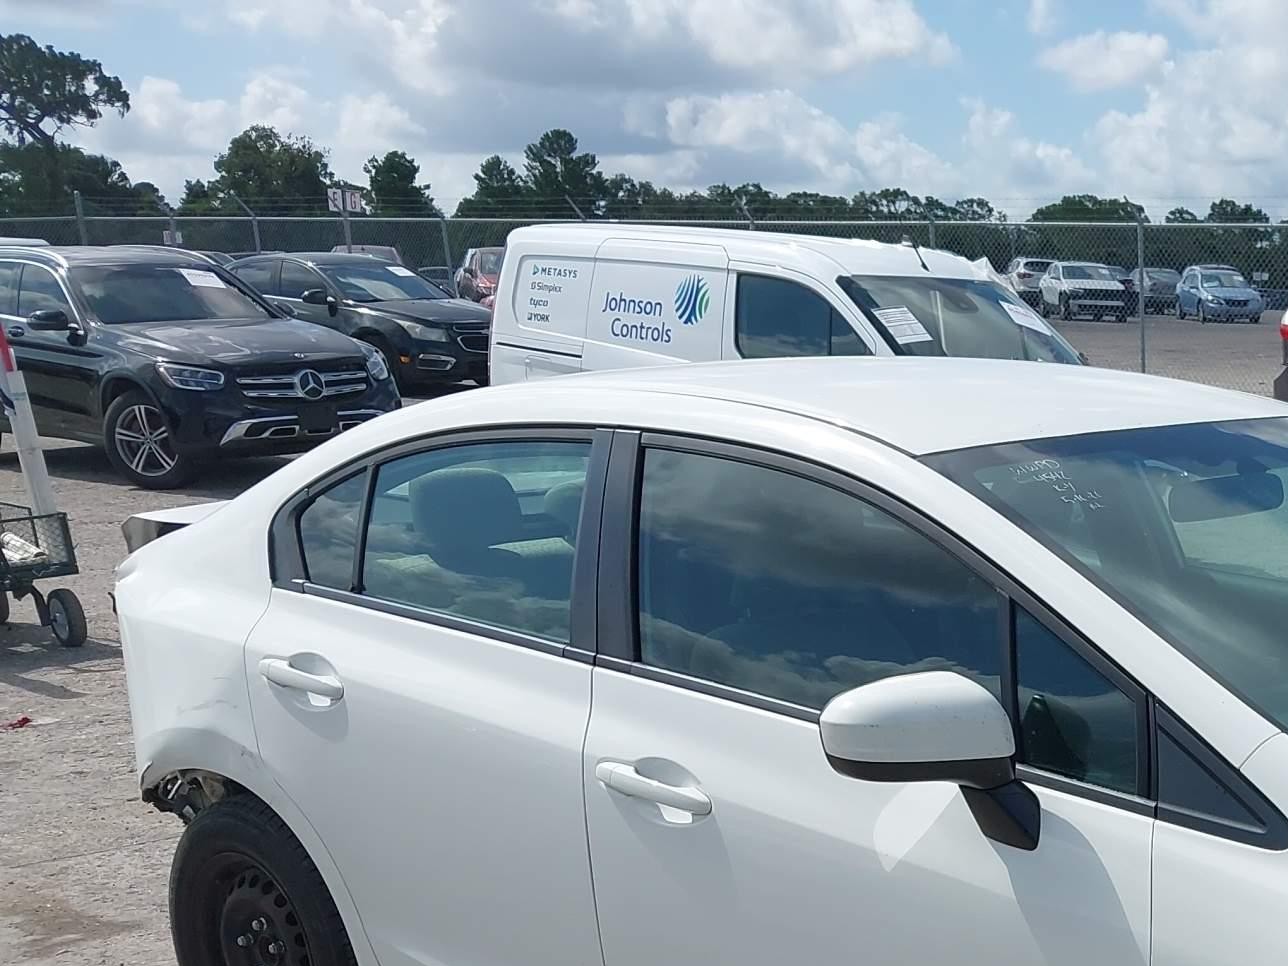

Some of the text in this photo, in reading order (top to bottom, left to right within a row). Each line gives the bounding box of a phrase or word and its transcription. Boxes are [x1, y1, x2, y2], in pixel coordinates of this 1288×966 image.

[540, 266, 578, 279] METASYS
[529, 297, 549, 308] tyco
[602, 291, 663, 317] Johnson
[533, 312, 550, 323] YORK
[610, 317, 672, 344] Controls
